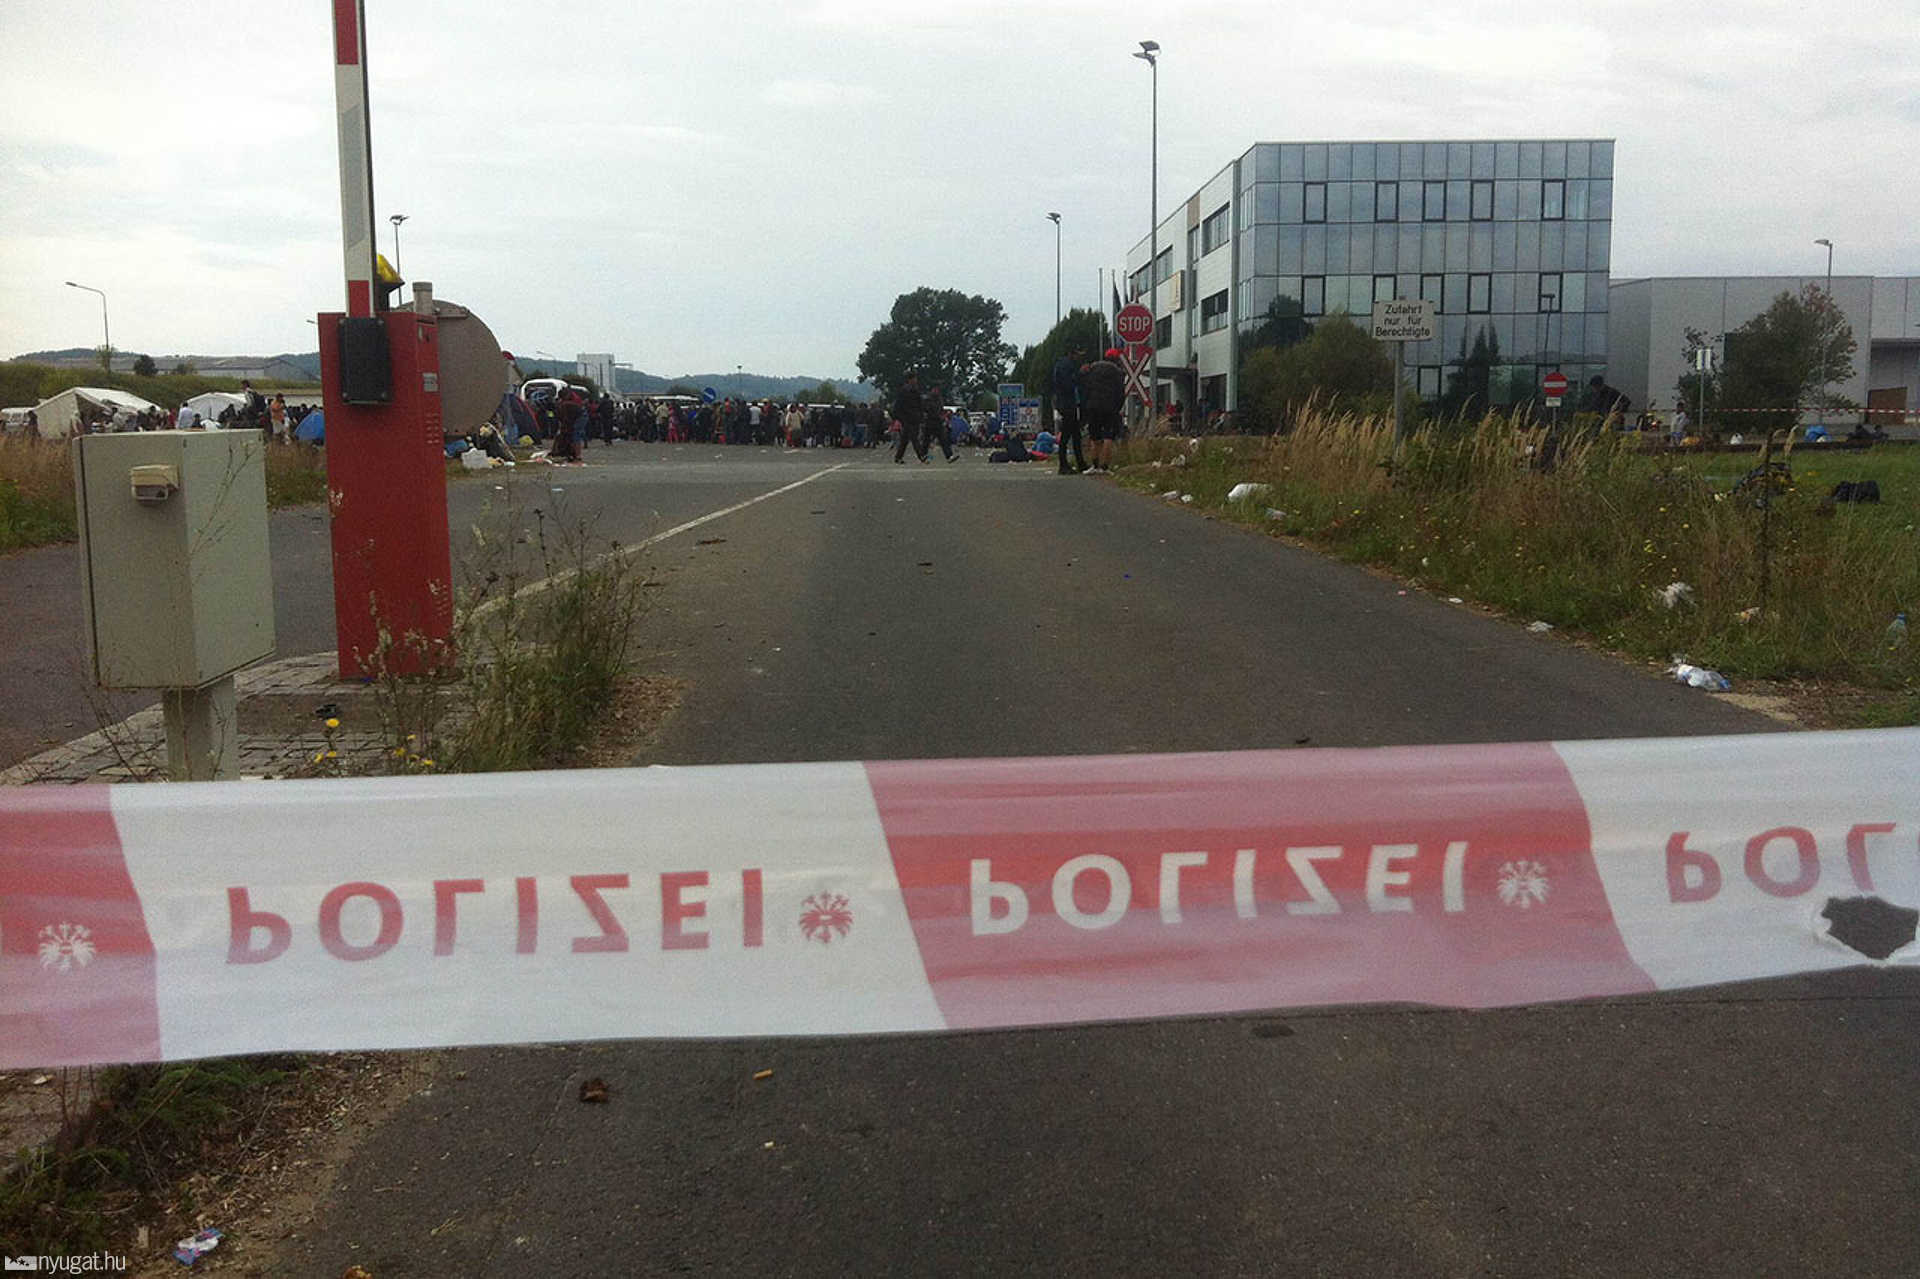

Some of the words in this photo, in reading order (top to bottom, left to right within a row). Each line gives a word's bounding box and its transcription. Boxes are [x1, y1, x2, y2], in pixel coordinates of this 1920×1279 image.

[1384, 303, 1422, 314] Zufahrt
[1119, 316, 1150, 332] STOP
[1384, 316, 1400, 325] nur
[1408, 315, 1422, 325] für
[1375, 326, 1431, 338] Berechtigte
